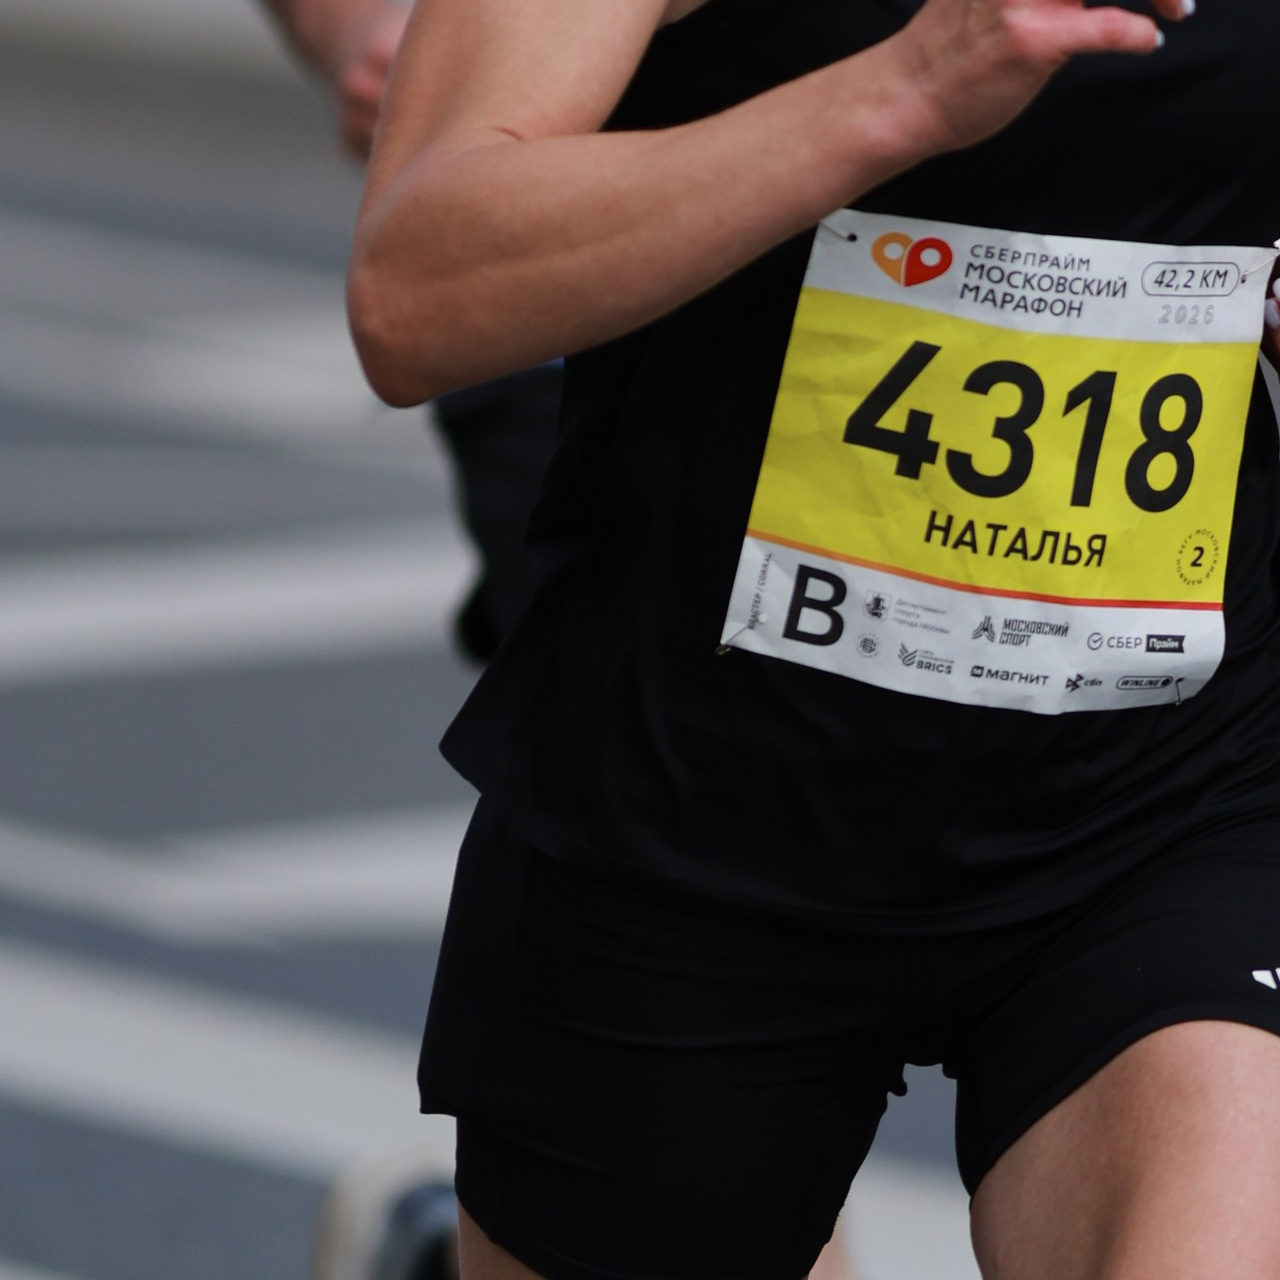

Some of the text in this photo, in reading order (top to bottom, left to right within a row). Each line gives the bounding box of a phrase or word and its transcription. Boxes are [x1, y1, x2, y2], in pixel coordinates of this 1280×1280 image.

[969, 244, 1091, 272] СБЕРПРАЙМ
[963, 262, 1129, 299] МОСКОВСКИЙ
[1153, 268, 1194, 289] 42,2
[959, 283, 1084, 319] МАРАФОН
[1158, 304, 1215, 325] 2026
[842, 340, 1203, 513] 4318
[924, 510, 1108, 568] НАТАЛЬЯ
[1189, 546, 1205, 568] 2
[1001, 618, 1070, 637] МОСКОВСКИЙ
[999, 632, 1032, 647] СПОРТ
[1106, 635, 1180, 650] СБЕР Прайм
[915, 660, 954, 675] BRICS
[985, 668, 1050, 686] магнит
[1119, 678, 1162, 688] WINLINE
